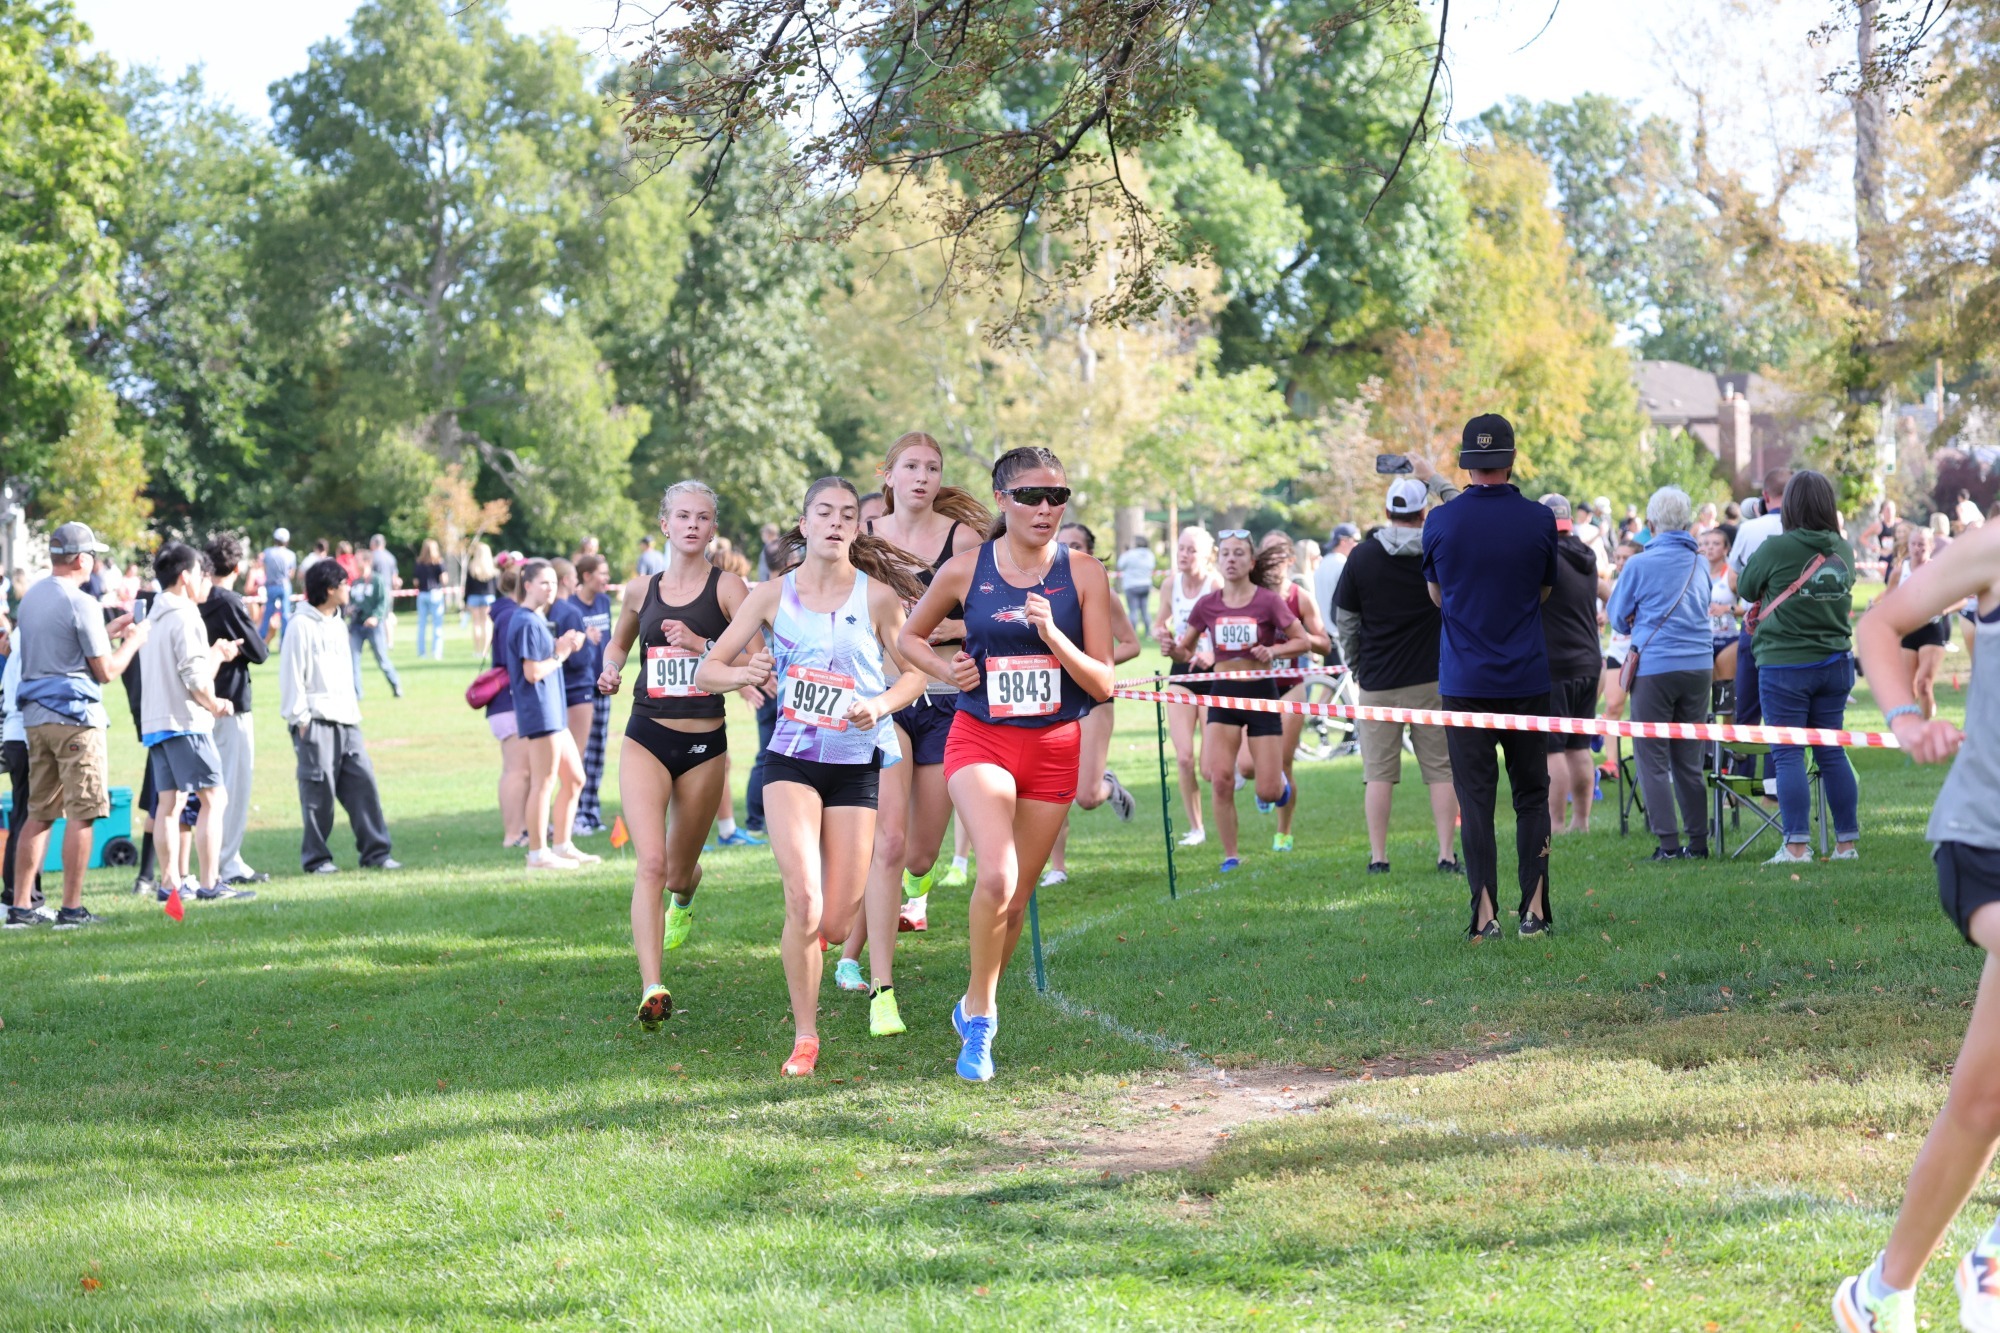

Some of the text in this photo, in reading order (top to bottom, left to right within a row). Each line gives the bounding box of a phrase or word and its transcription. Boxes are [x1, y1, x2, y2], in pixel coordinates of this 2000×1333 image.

[1222, 625, 1251, 643] 9926
[656, 658, 699, 687] 9917
[998, 670, 1051, 704] 9843
[793, 680, 843, 716] 9927
